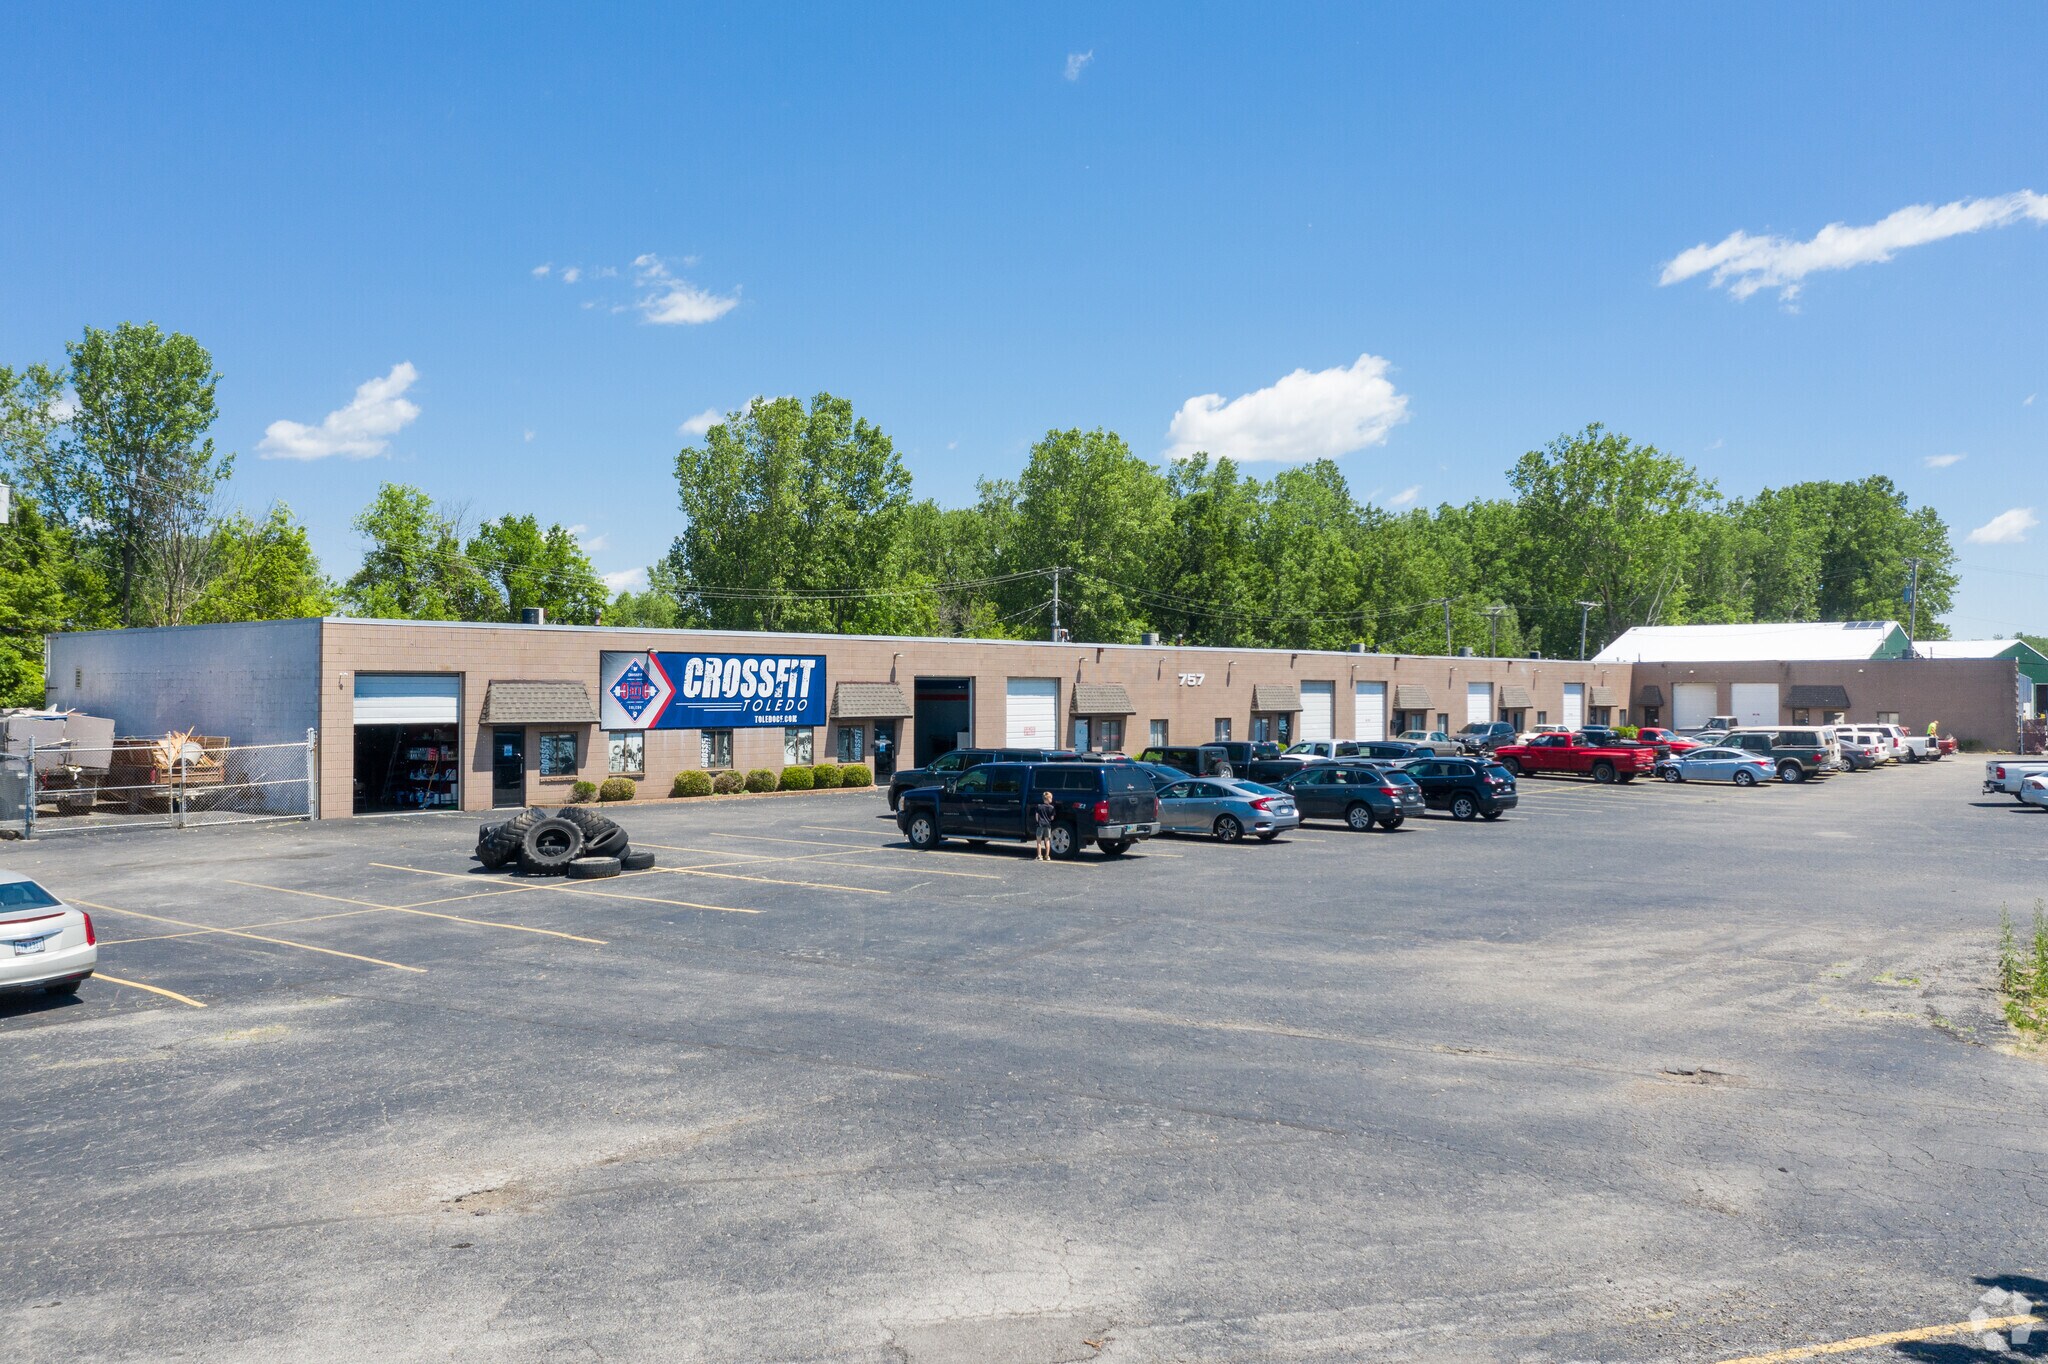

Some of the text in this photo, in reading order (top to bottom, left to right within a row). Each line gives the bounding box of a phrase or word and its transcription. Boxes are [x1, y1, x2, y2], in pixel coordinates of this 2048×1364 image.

[683, 657, 816, 698] CROSSFIT
[1178, 673, 1206, 687] 757
[742, 699, 808, 712] TOLEDO
[754, 715, 798, 724] TOLEDOCF.COM
